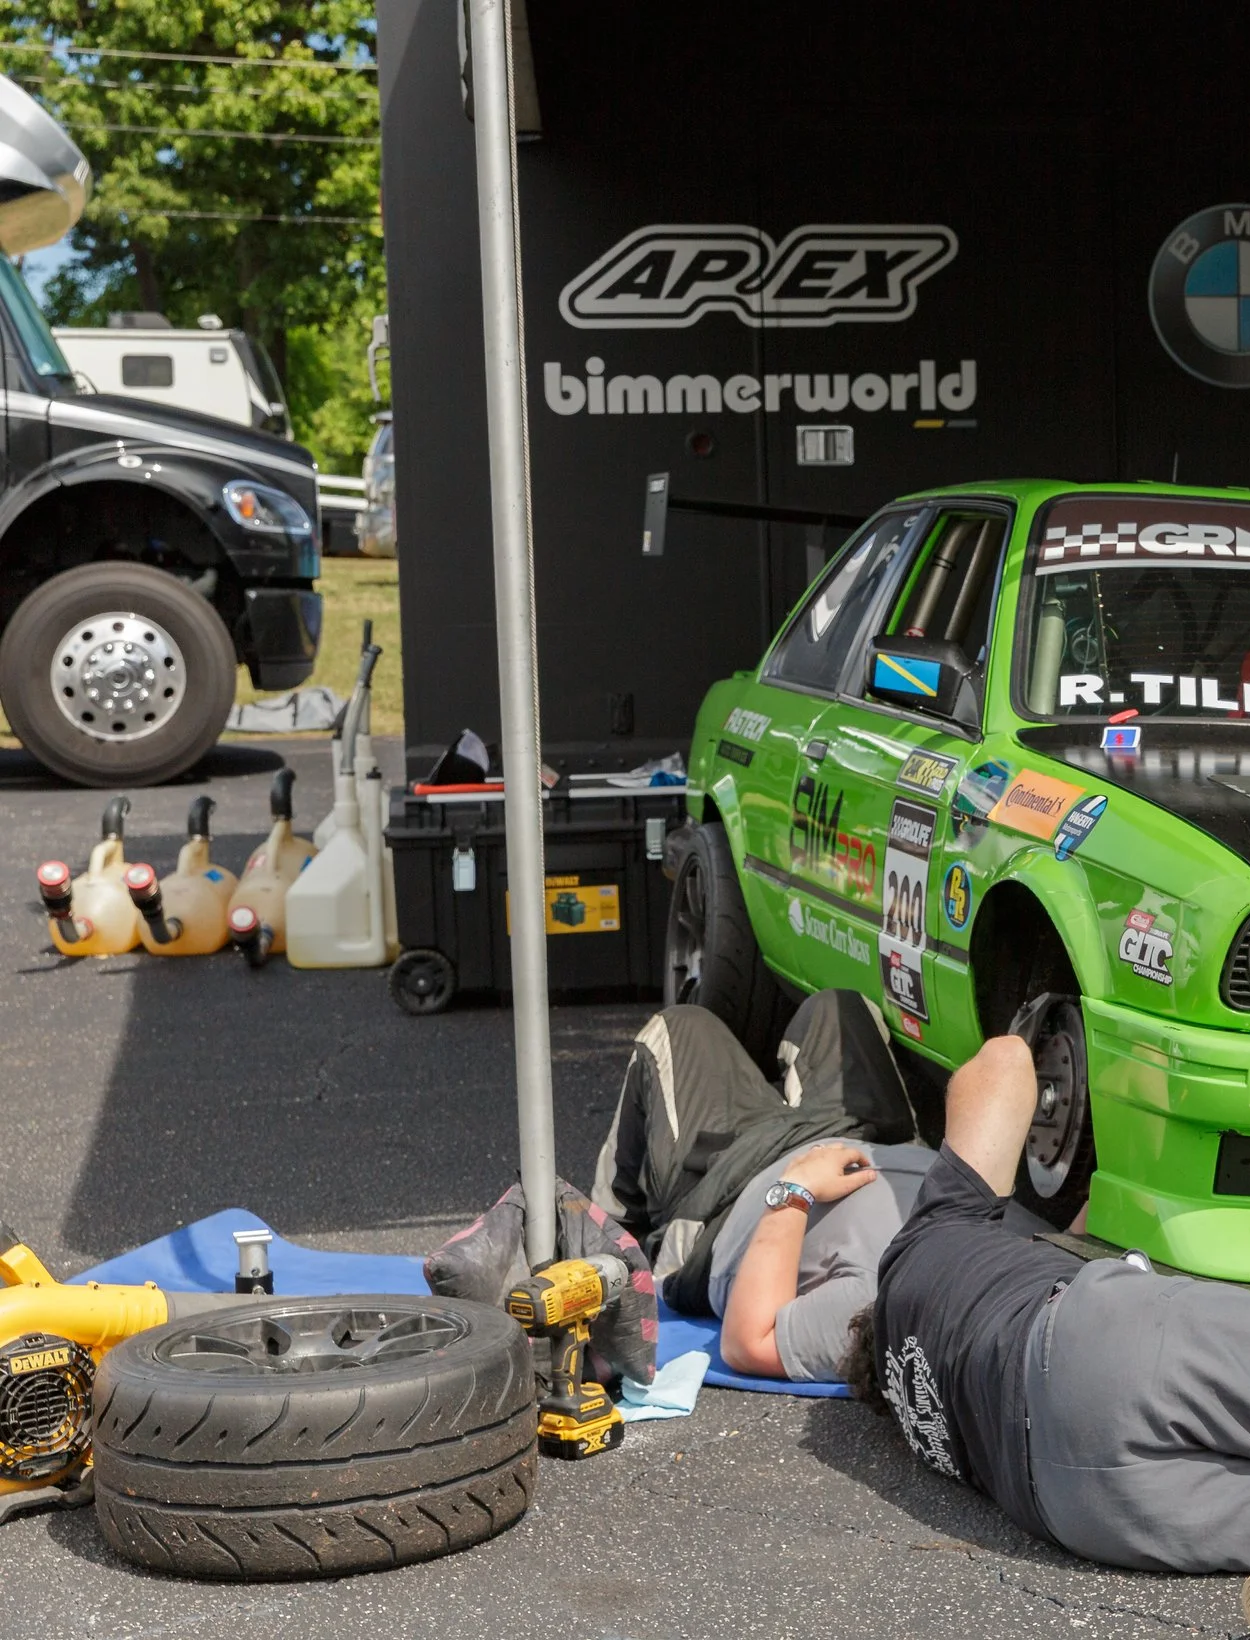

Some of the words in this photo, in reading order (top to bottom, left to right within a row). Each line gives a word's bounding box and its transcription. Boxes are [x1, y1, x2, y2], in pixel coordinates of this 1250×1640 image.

[543, 356, 977, 416] bimmerworld
[1006, 784, 1057, 815] Continental
[1067, 810, 1095, 830] HAGERTY
[1120, 928, 1173, 972] GLTC
[11, 1348, 70, 1374] DEWALT
